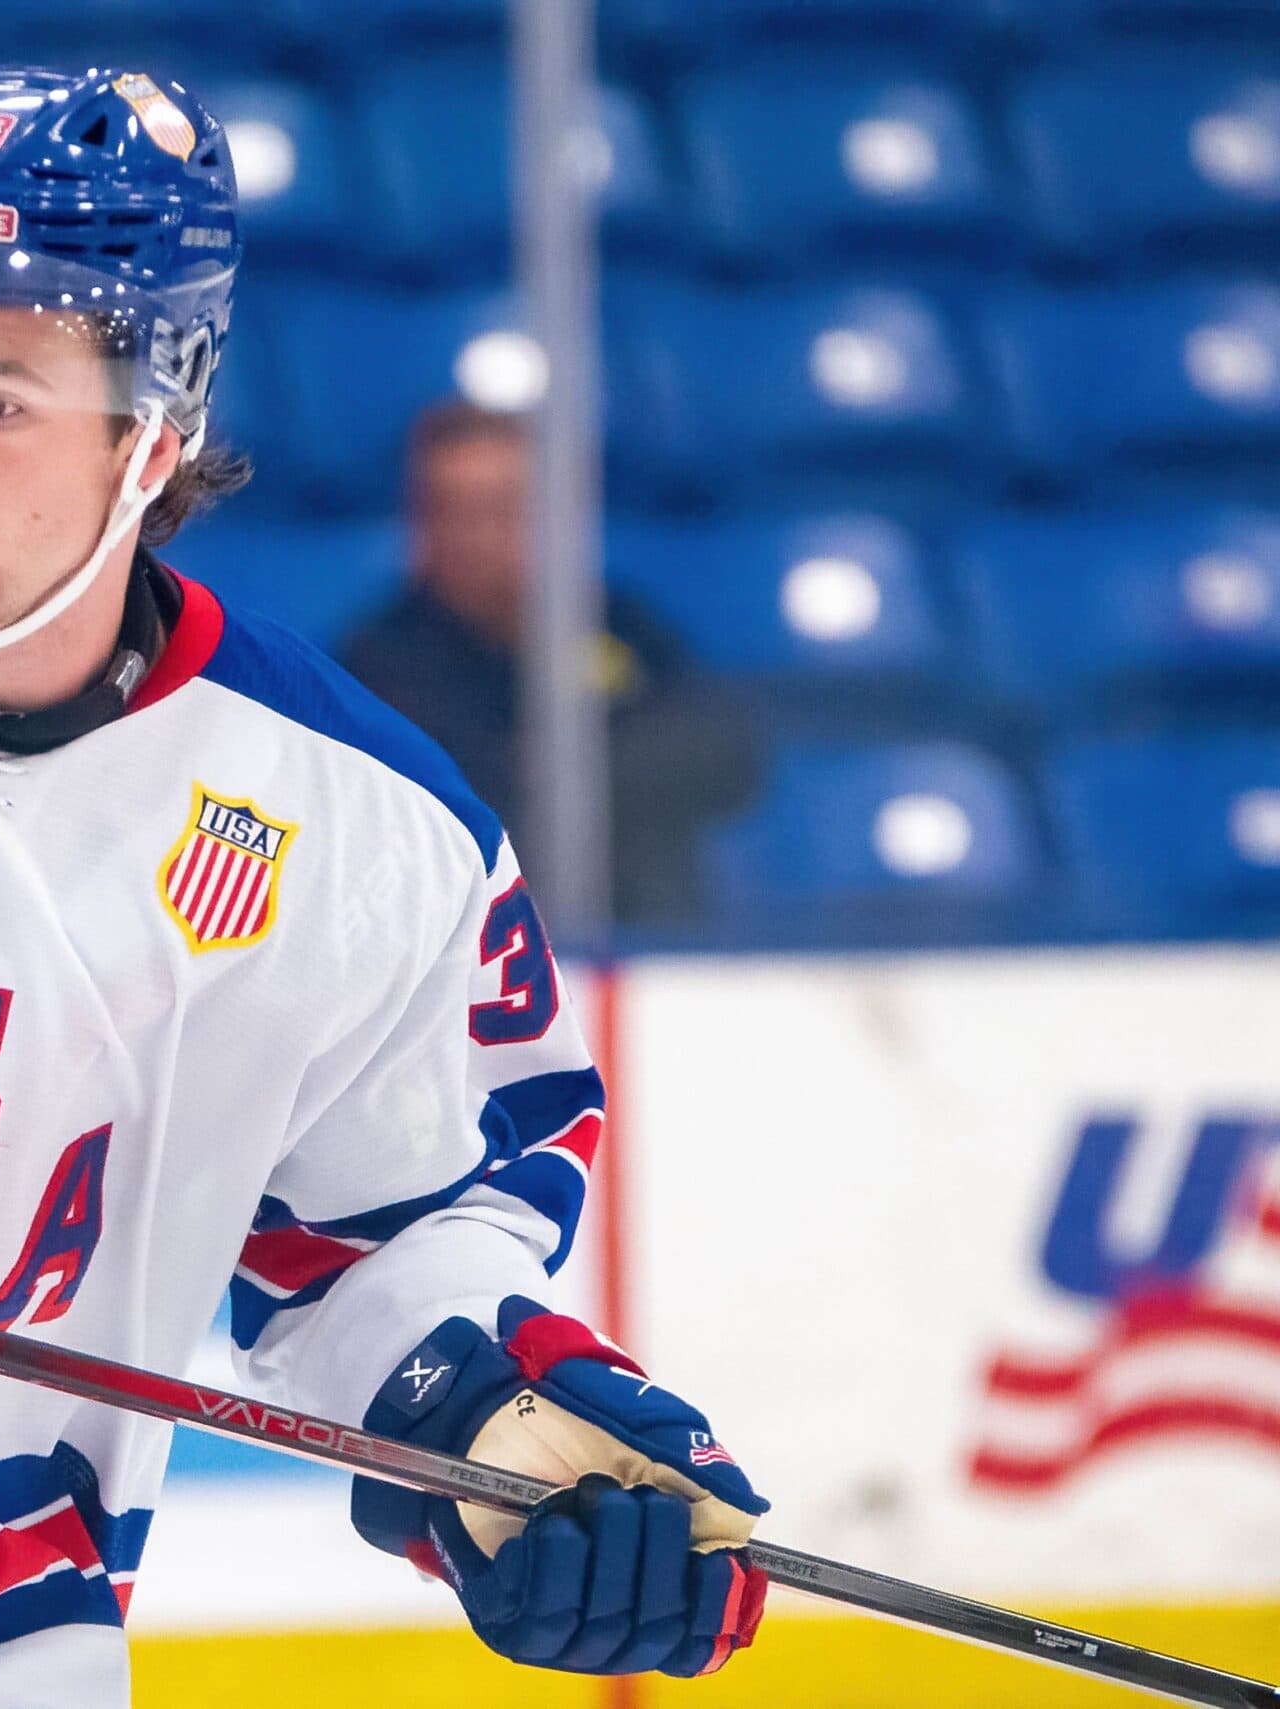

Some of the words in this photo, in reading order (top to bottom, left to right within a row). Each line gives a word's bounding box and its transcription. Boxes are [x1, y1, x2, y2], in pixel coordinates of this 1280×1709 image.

[209, 804, 269, 855] USA
[515, 1393, 537, 1418] CE
[449, 1465, 489, 1487] FEEL
[495, 1477, 527, 1496] THE
